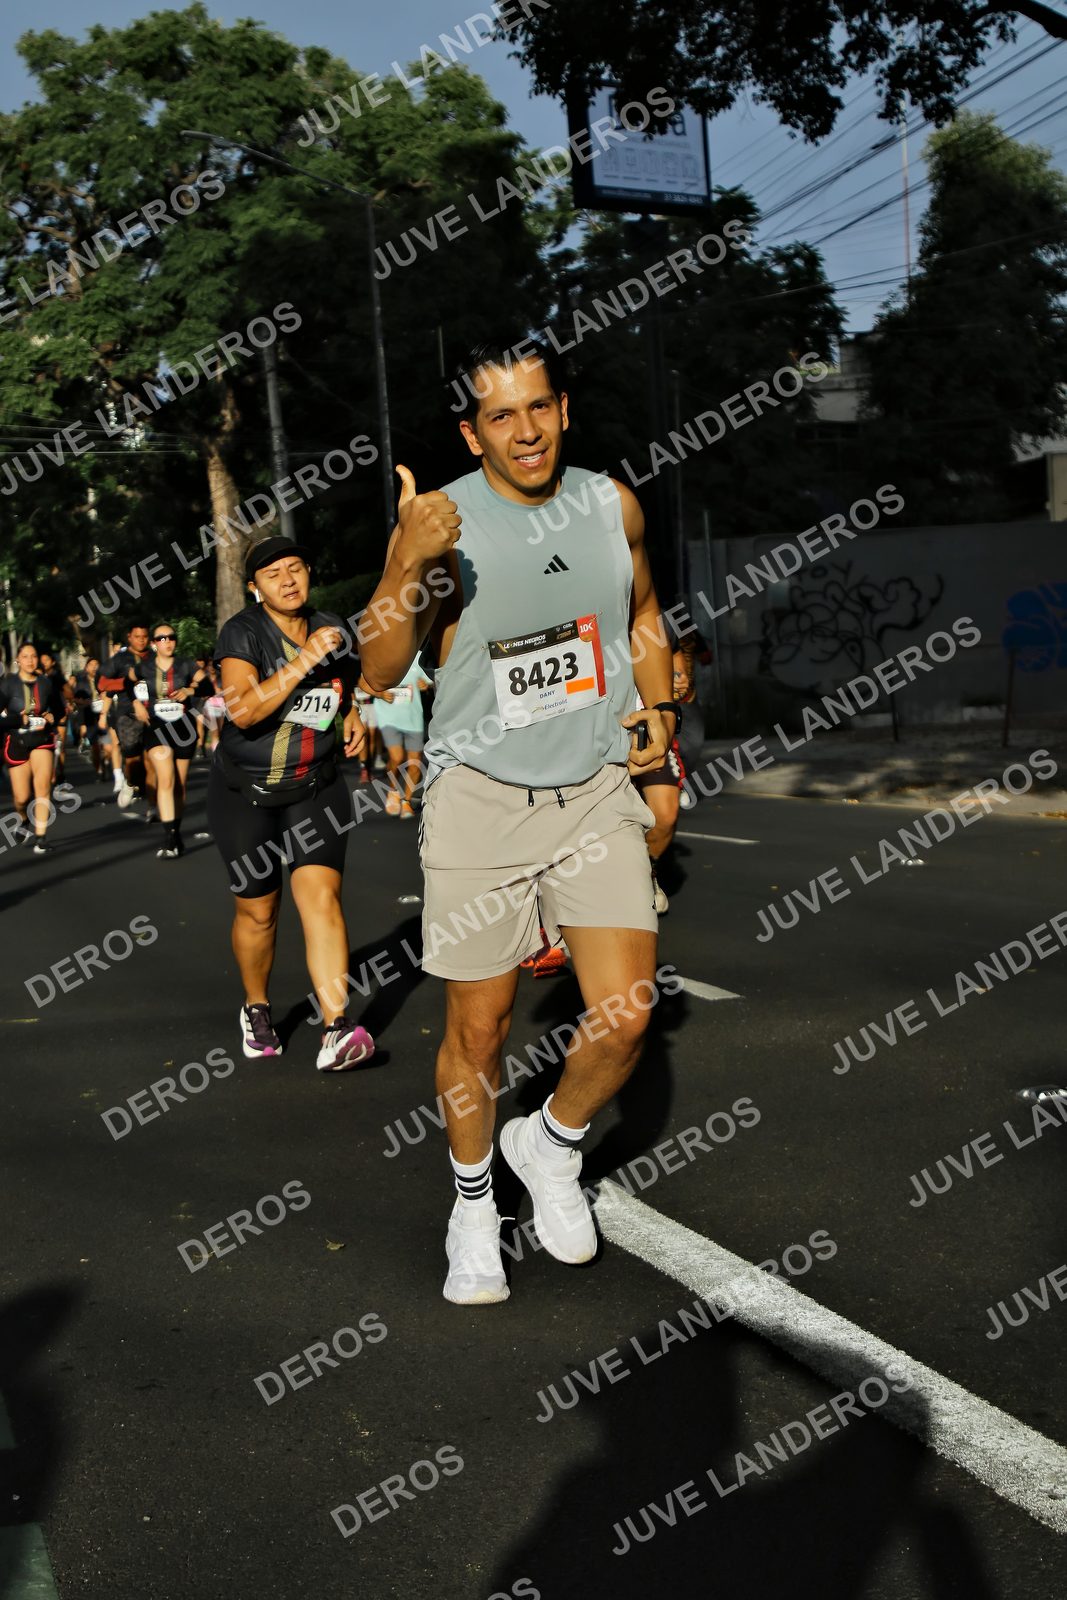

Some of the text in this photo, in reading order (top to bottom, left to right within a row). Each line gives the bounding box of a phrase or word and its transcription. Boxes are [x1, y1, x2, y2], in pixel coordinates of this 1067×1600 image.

[508, 652, 579, 695] 8423
[539, 690, 556, 699] DANY
[292, 695, 331, 713] 9714
